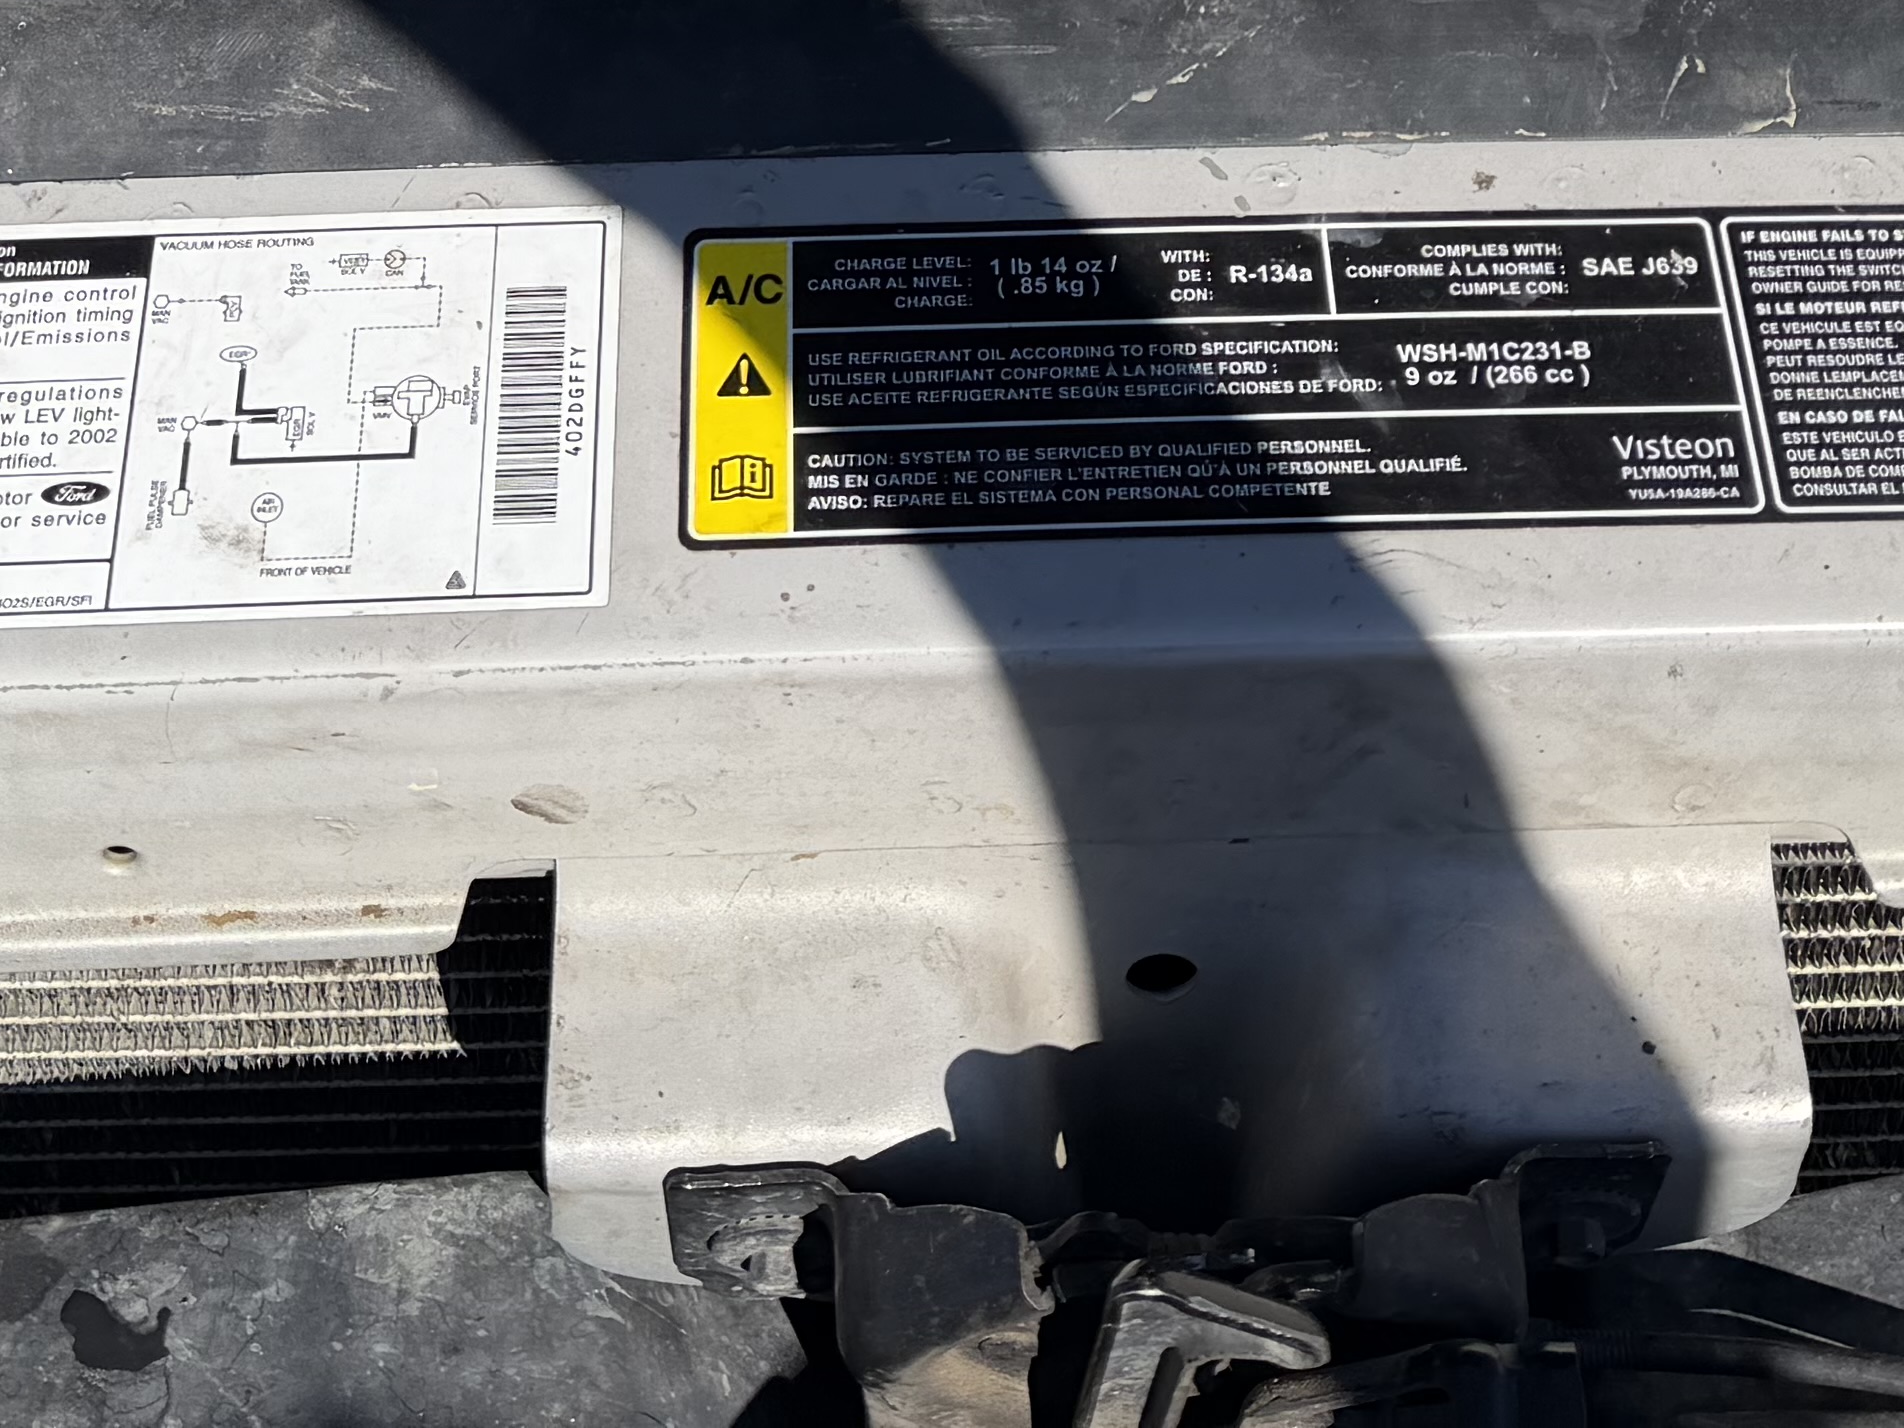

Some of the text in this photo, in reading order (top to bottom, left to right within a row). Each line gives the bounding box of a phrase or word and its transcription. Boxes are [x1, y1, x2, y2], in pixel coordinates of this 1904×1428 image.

[160, 237, 314, 251] VACUUM HOSE ROUTING
[1741, 230, 1755, 243] IF
[1759, 230, 1818, 243] ENGINE
[1821, 229, 1864, 242] FAILS
[1867, 229, 1889, 242] TO
[1160, 250, 1210, 263] WITH:
[1420, 243, 1562, 258] COMPLIES WITH:
[1744, 249, 1776, 262] THIS
[1778, 249, 1837, 261] VEHICLE
[1839, 248, 1853, 260] IS
[834, 256, 971, 271] CHARGE LEVEL:
[990, 258, 999, 275] 1
[1011, 258, 1032, 275] lb
[1041, 256, 1067, 274] 14
[1076, 260, 1103, 273] oz
[1582, 255, 1698, 276] SAE J639
[1229, 264, 1313, 283] R-134a
[64, 285, 136, 302] control
[706, 274, 784, 305] A/C
[1755, 303, 1771, 315] SI
[1775, 302, 1795, 315] LE
[1799, 301, 1867, 315] MOTEUR
[1396, 341, 1591, 363] WSH-M1C231-B
[1404, 366, 1420, 386] 9
[1427, 370, 1457, 385] oz
[1486, 365, 1538, 388] (266
[1545, 368, 1574, 383] cc
[566, 347, 586, 457] 402DGFFY
[807, 439, 1371, 468] CAUTION: SYSTEM TO BE SERVICED BY QUALIFIED PERSONNEL.
[1612, 435, 1735, 460] Visteon
[1621, 464, 1739, 480] PLYMOUTH, MI
[260, 565, 351, 577] FRONT OF VEHICLE
